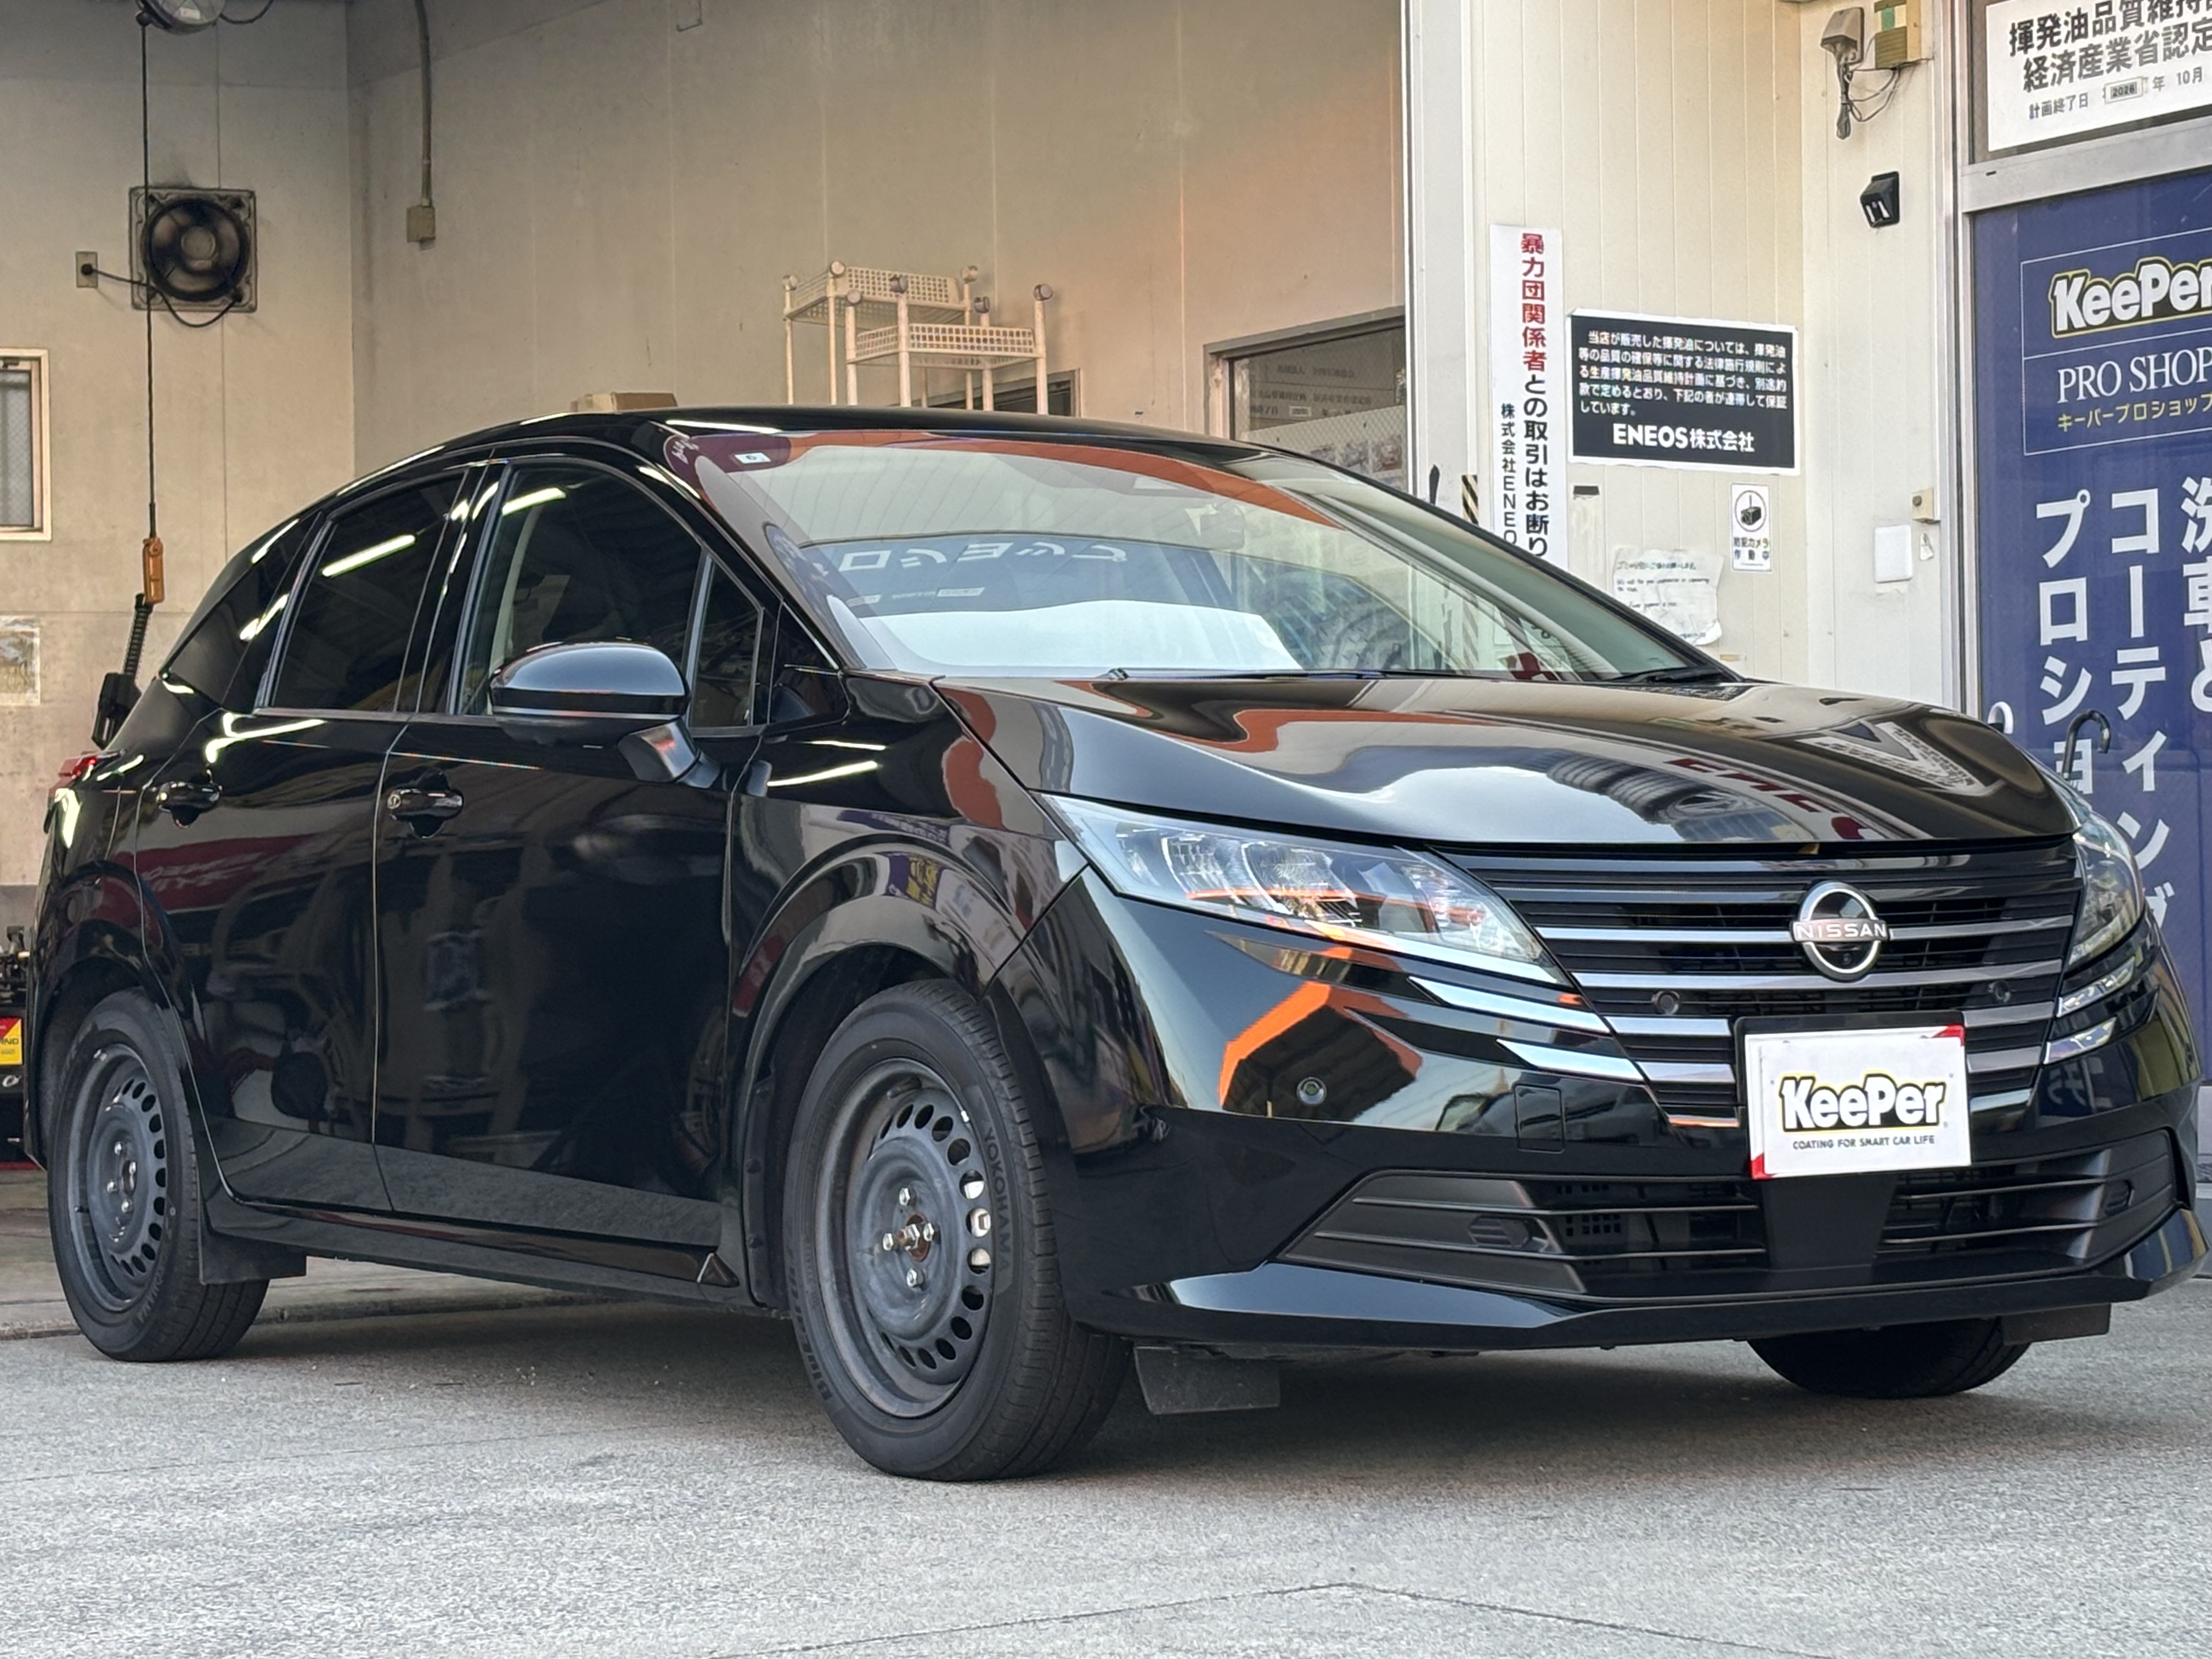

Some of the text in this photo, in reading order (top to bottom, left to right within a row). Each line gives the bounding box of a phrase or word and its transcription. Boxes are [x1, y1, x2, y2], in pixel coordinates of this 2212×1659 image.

[2057, 346, 2212, 403] PRO SHOP
[1581, 400, 1635, 416] しています。
[1796, 923, 1887, 939] NISSAN
[1780, 1074, 1945, 1131] KeePer
[1793, 1135, 1935, 1150] COATING FOR SMART CAR LIFE
